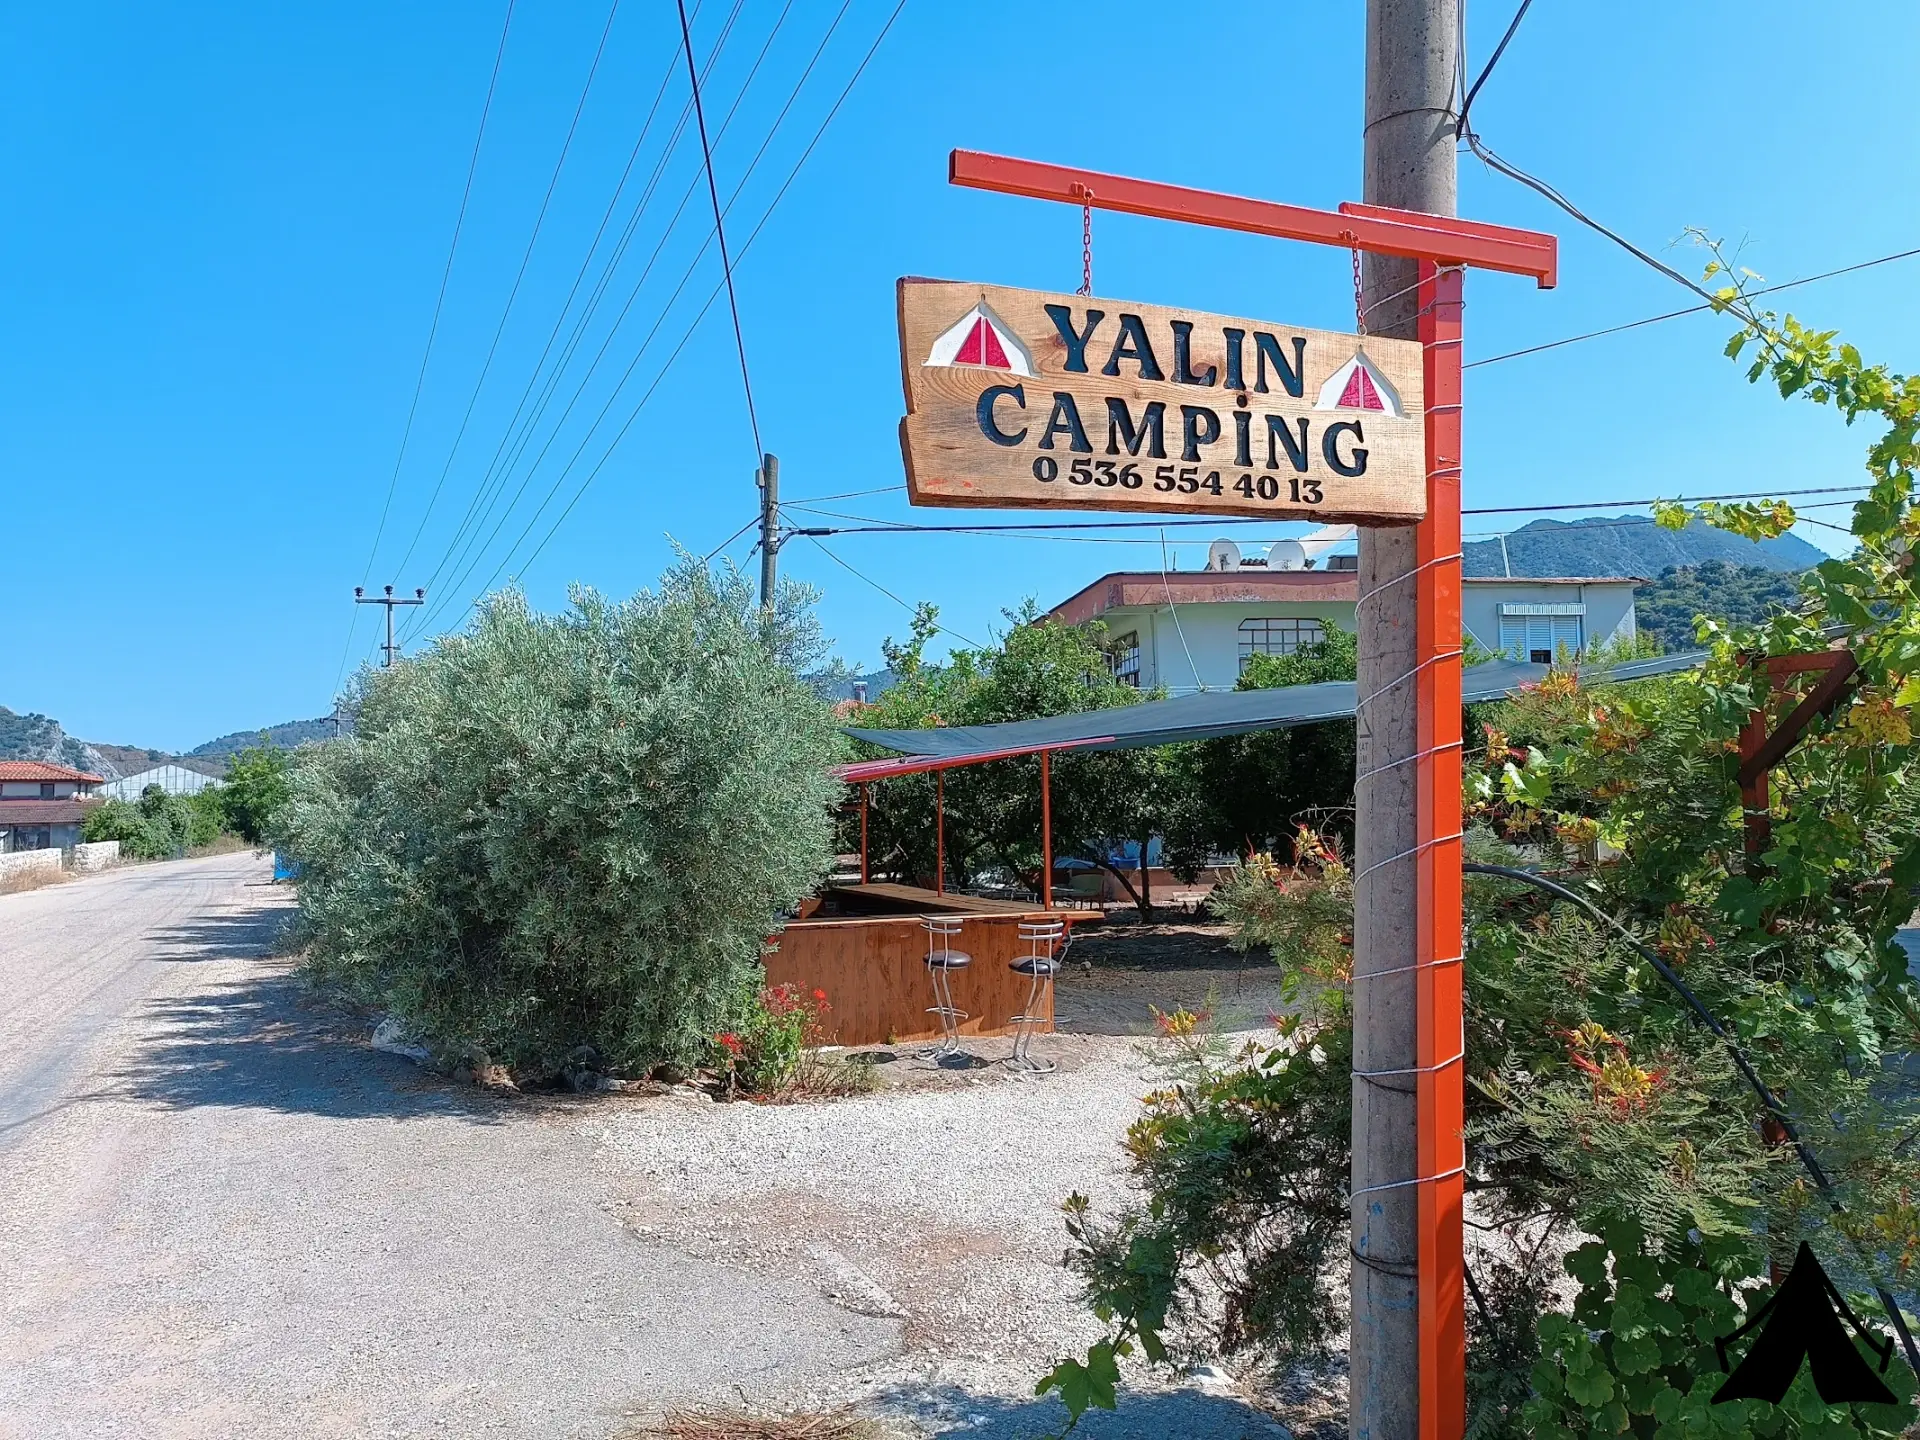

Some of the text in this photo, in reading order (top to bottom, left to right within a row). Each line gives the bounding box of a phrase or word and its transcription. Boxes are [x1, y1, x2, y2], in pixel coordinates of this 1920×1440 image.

[1043, 303, 1307, 399] YALIN
[1032, 456, 1324, 504] 0 536 554 40 13
